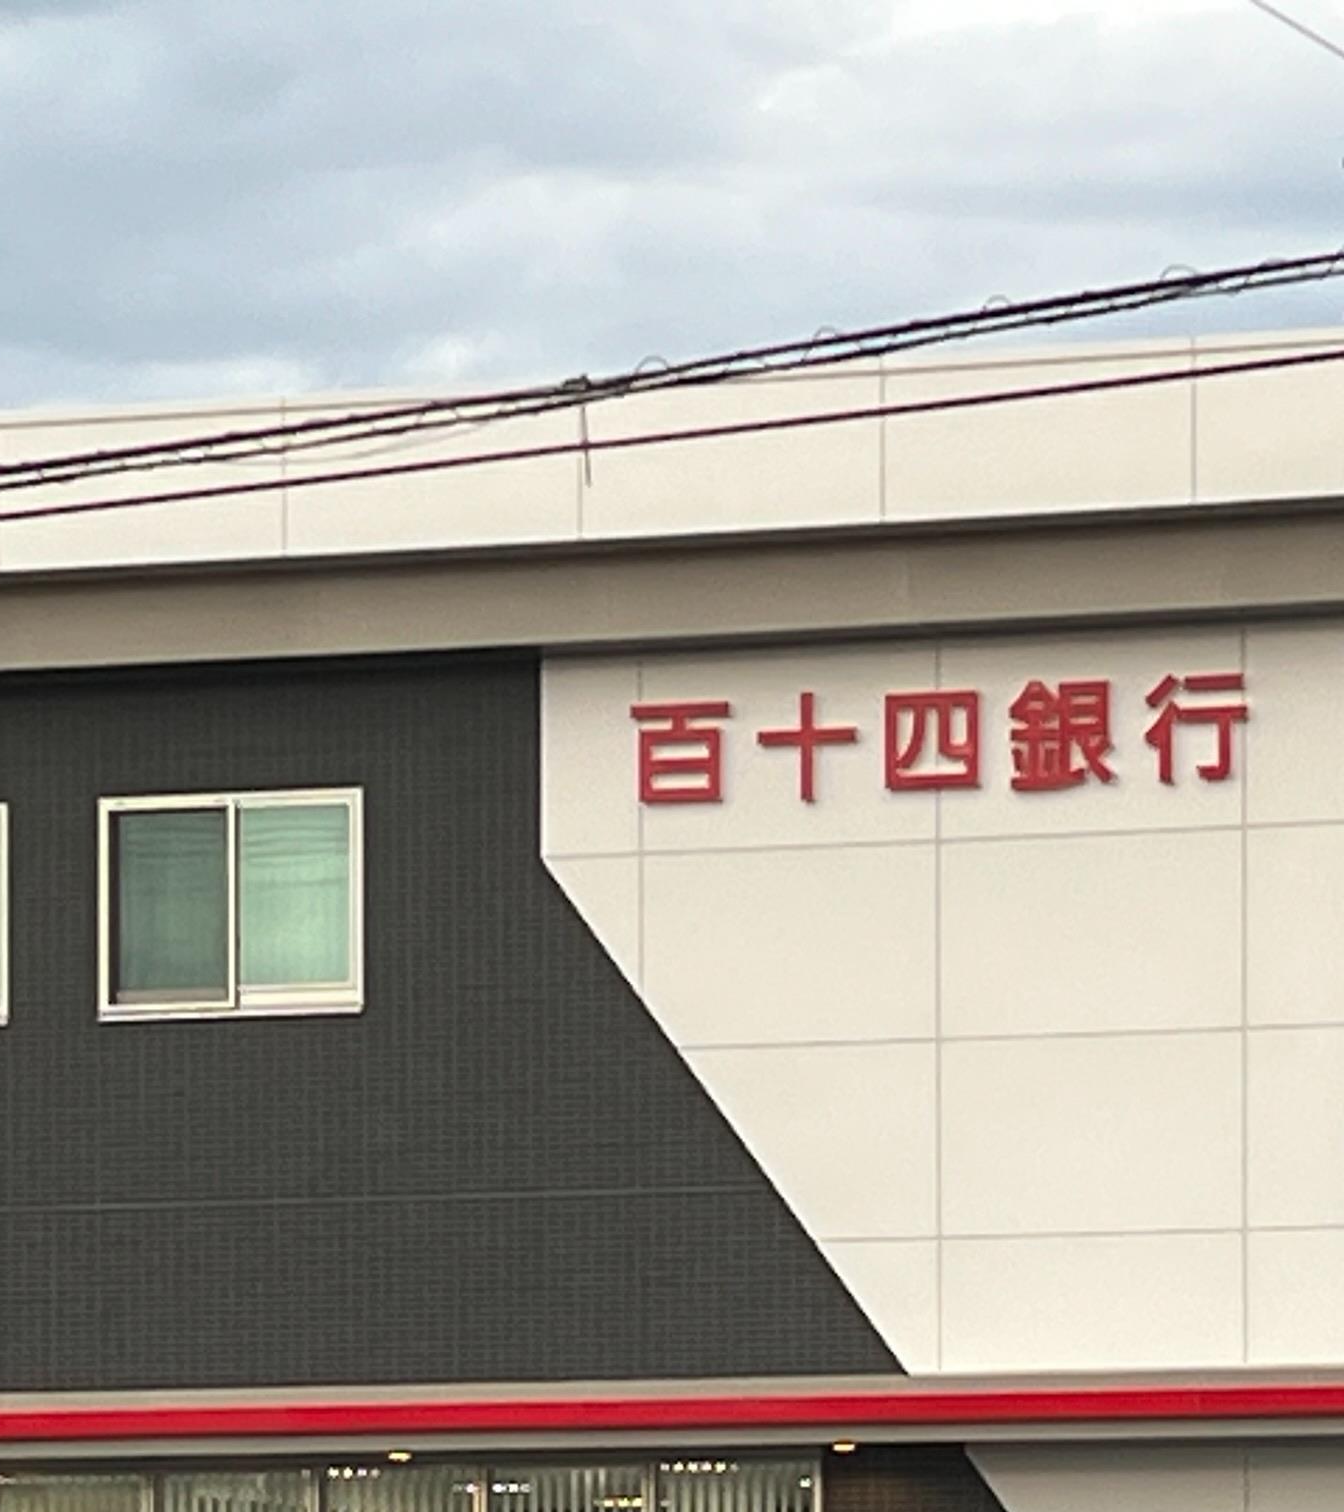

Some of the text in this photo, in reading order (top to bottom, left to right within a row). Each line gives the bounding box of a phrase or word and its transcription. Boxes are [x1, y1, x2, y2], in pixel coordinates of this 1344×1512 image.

[630, 673, 1248, 804] 百十四銀行
